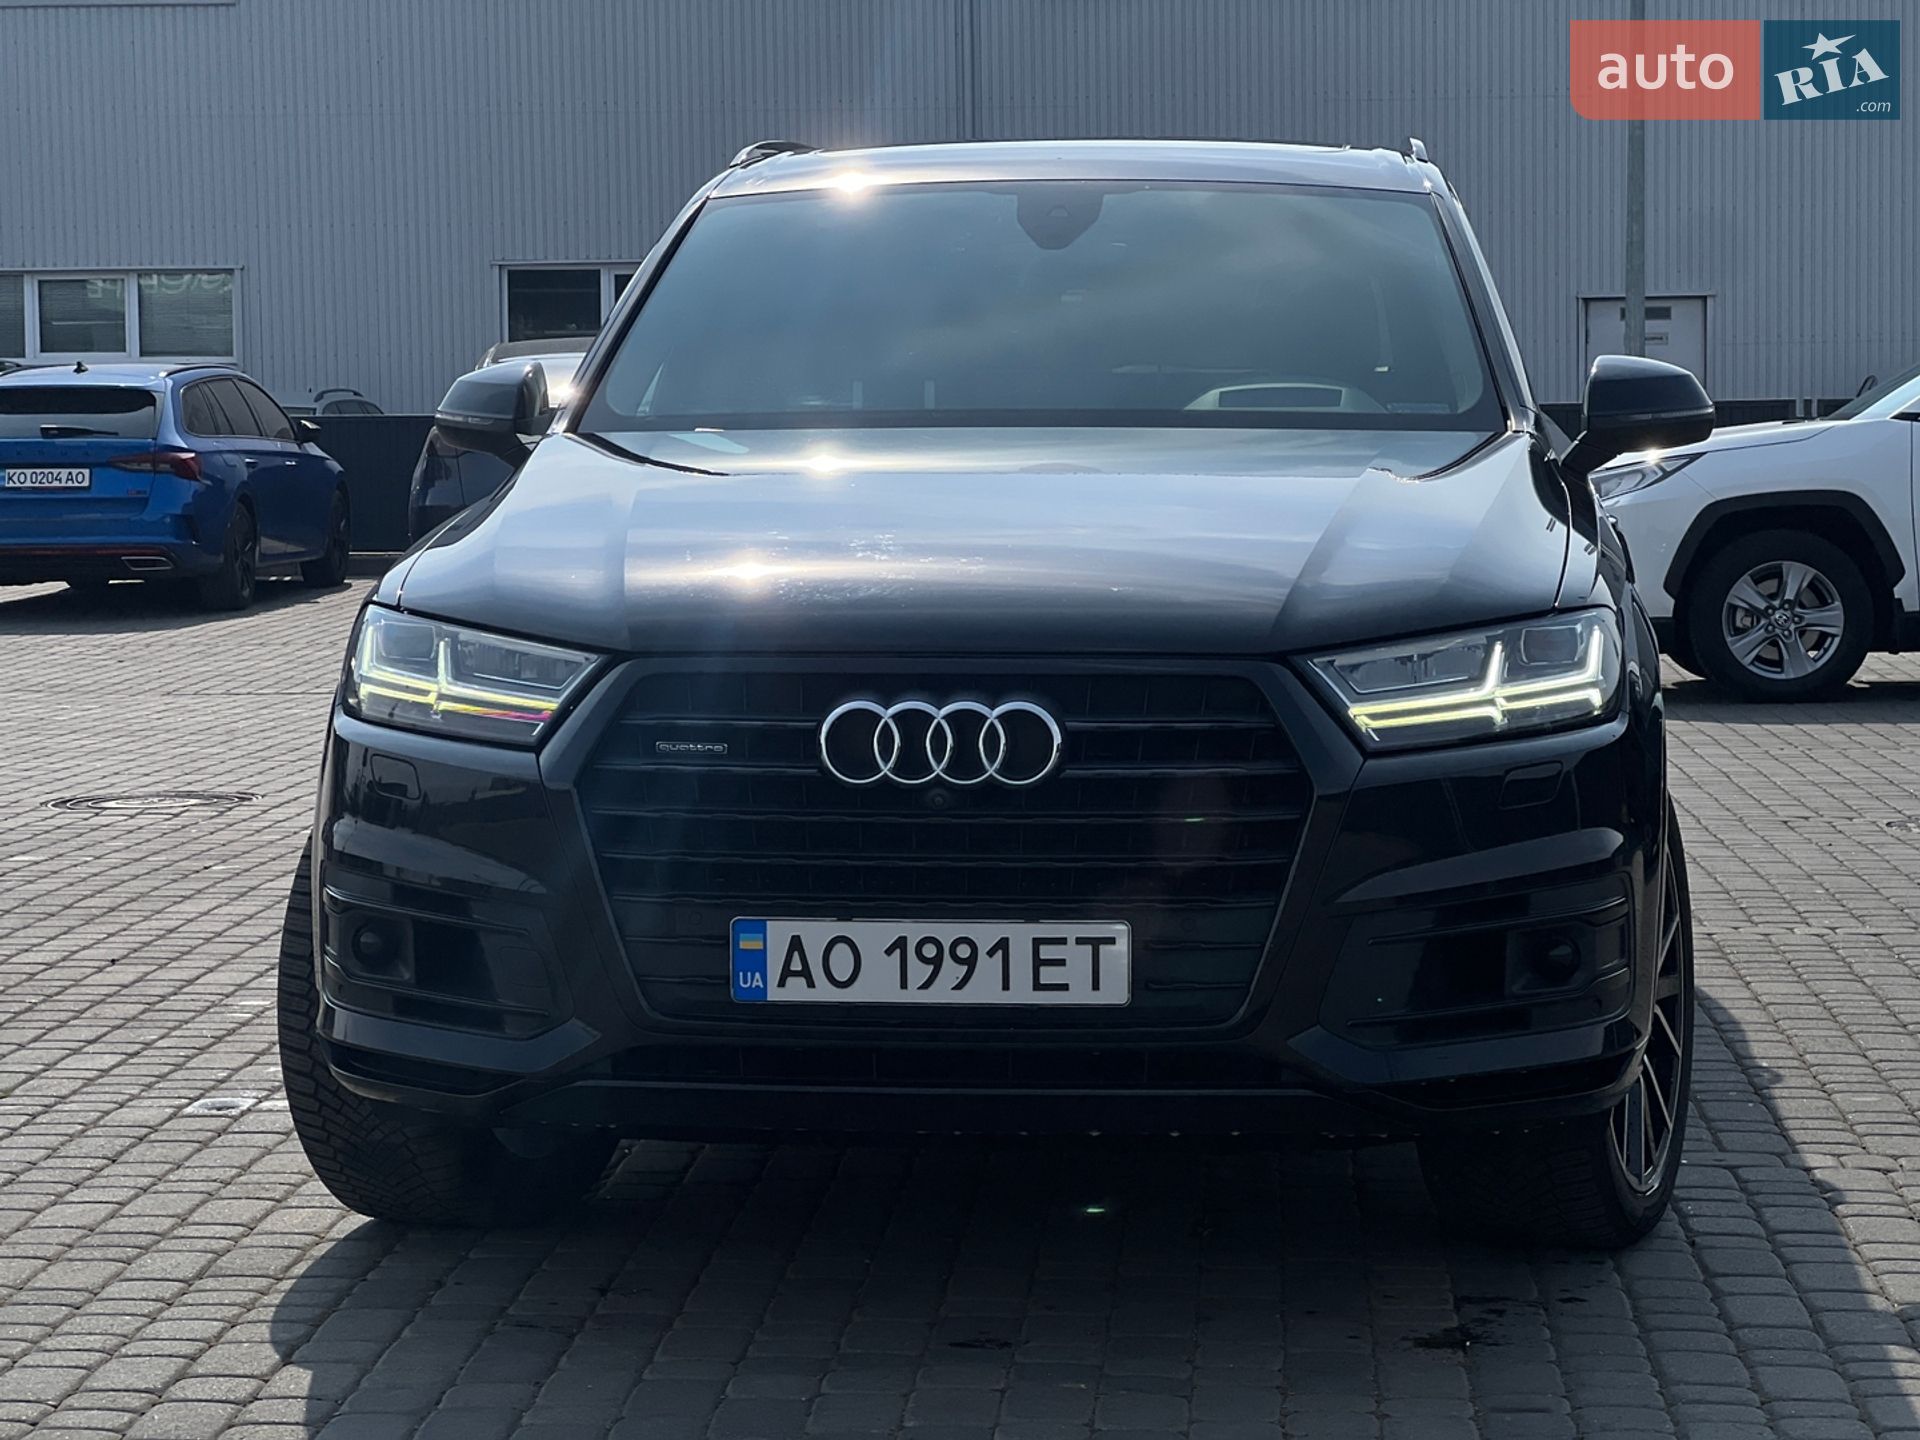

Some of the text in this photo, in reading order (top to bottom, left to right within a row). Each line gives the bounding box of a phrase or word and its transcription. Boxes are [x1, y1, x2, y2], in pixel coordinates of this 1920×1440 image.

[7, 471, 86, 485] KO 0204 AO
[658, 743, 724, 752] quattro
[776, 934, 863, 989] AO
[739, 972, 764, 988] UA
